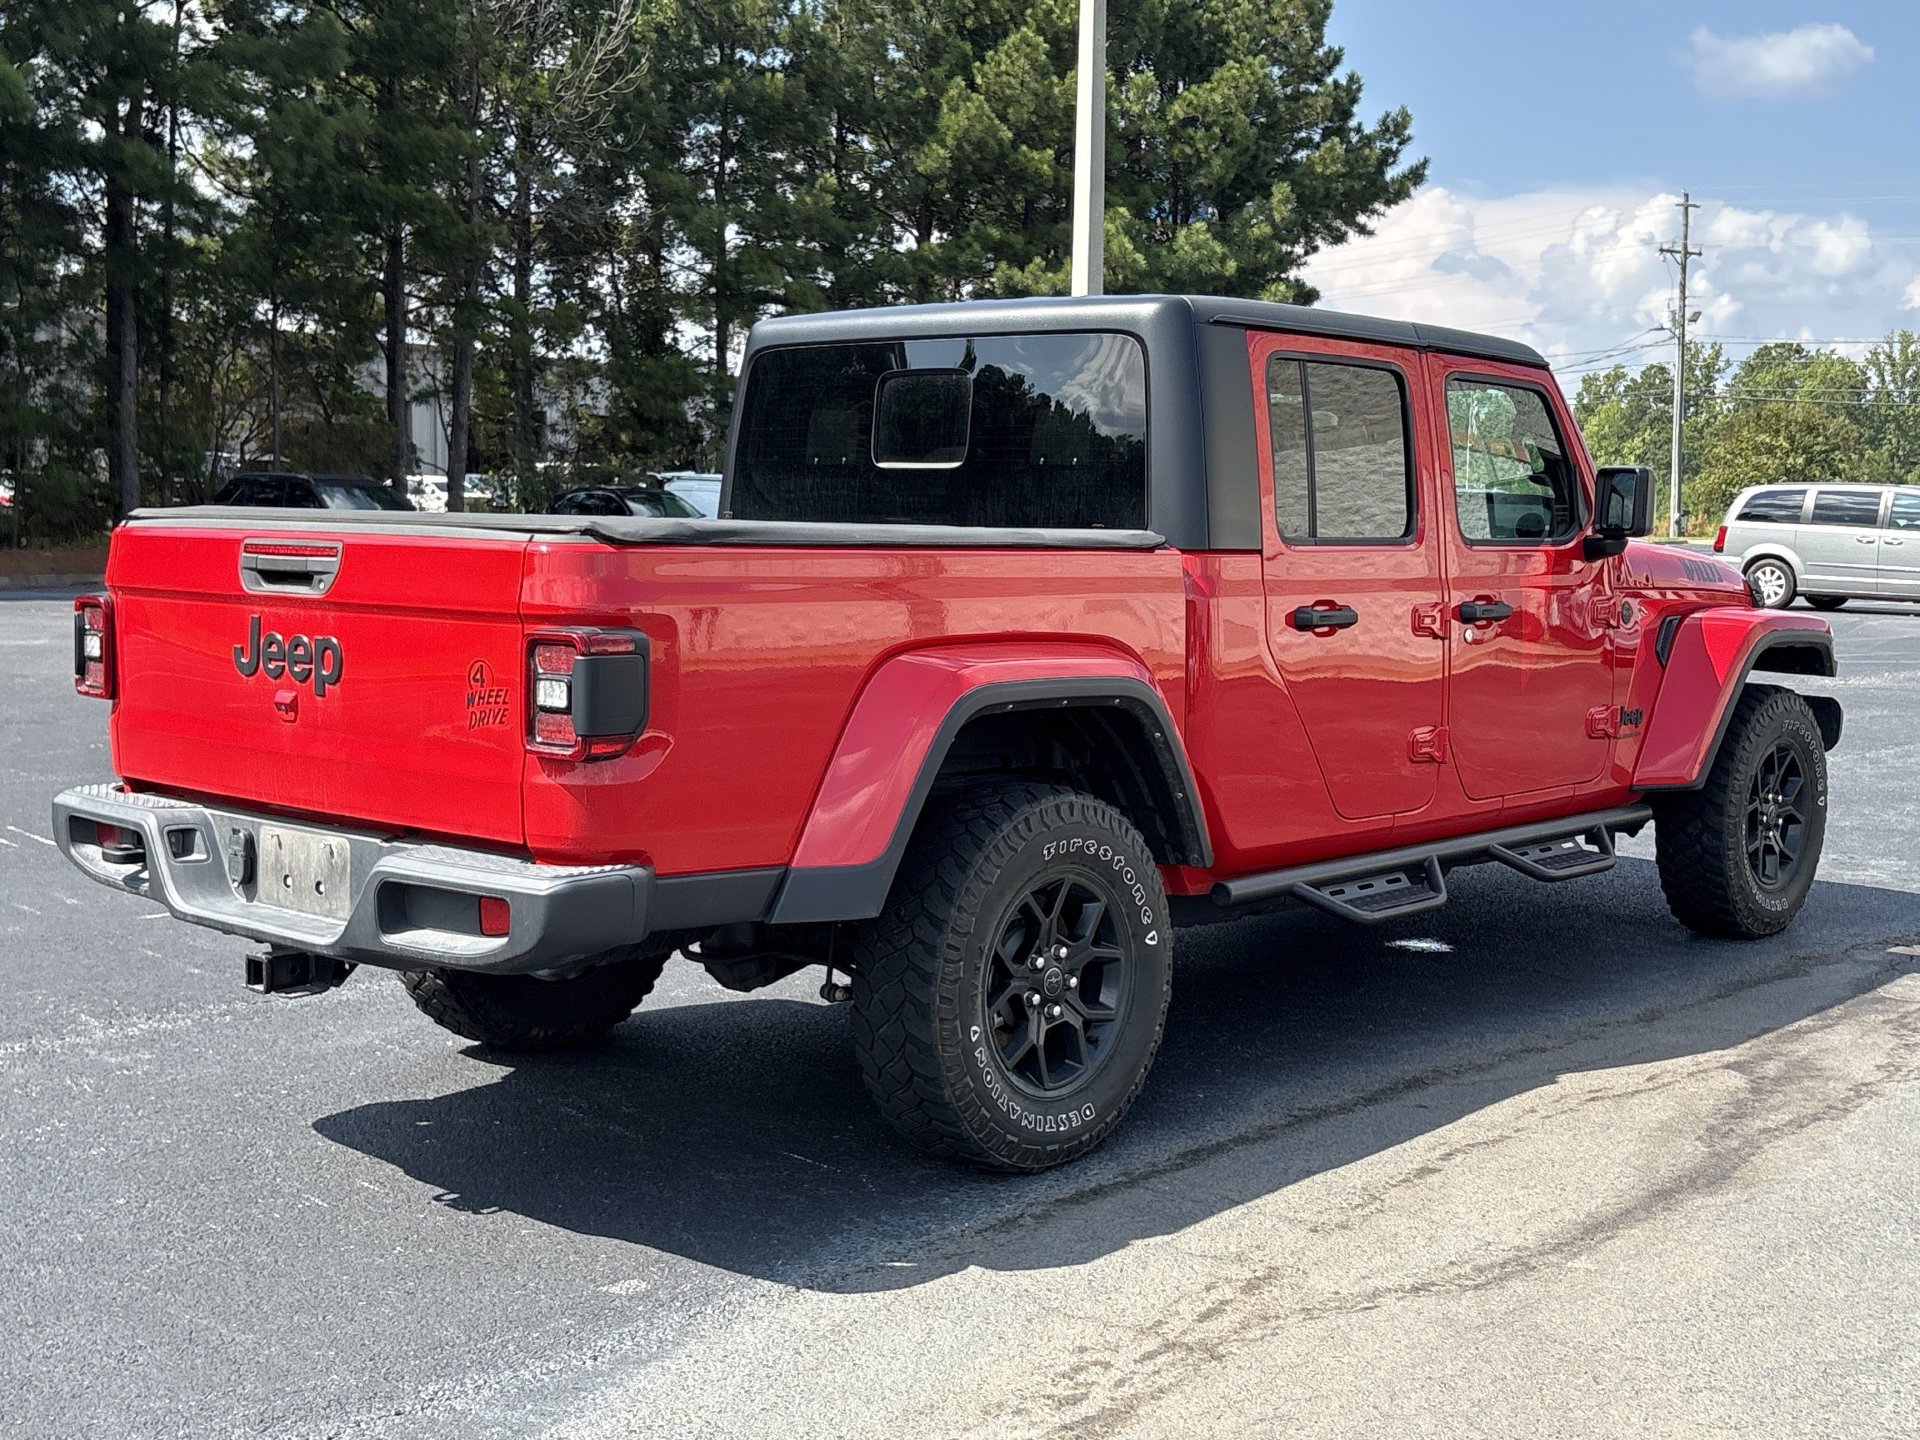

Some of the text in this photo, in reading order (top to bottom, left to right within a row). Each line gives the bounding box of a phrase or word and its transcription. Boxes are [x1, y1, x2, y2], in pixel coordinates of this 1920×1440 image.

[233, 614, 343, 698] Jeep
[472, 664, 486, 688] 4
[466, 688, 510, 709] WHEEL
[468, 707, 510, 731] DRIVE
[1618, 705, 1644, 728] Jeep
[1043, 838, 1153, 925] Firestone
[974, 1047, 1096, 1132] DESTINATION
